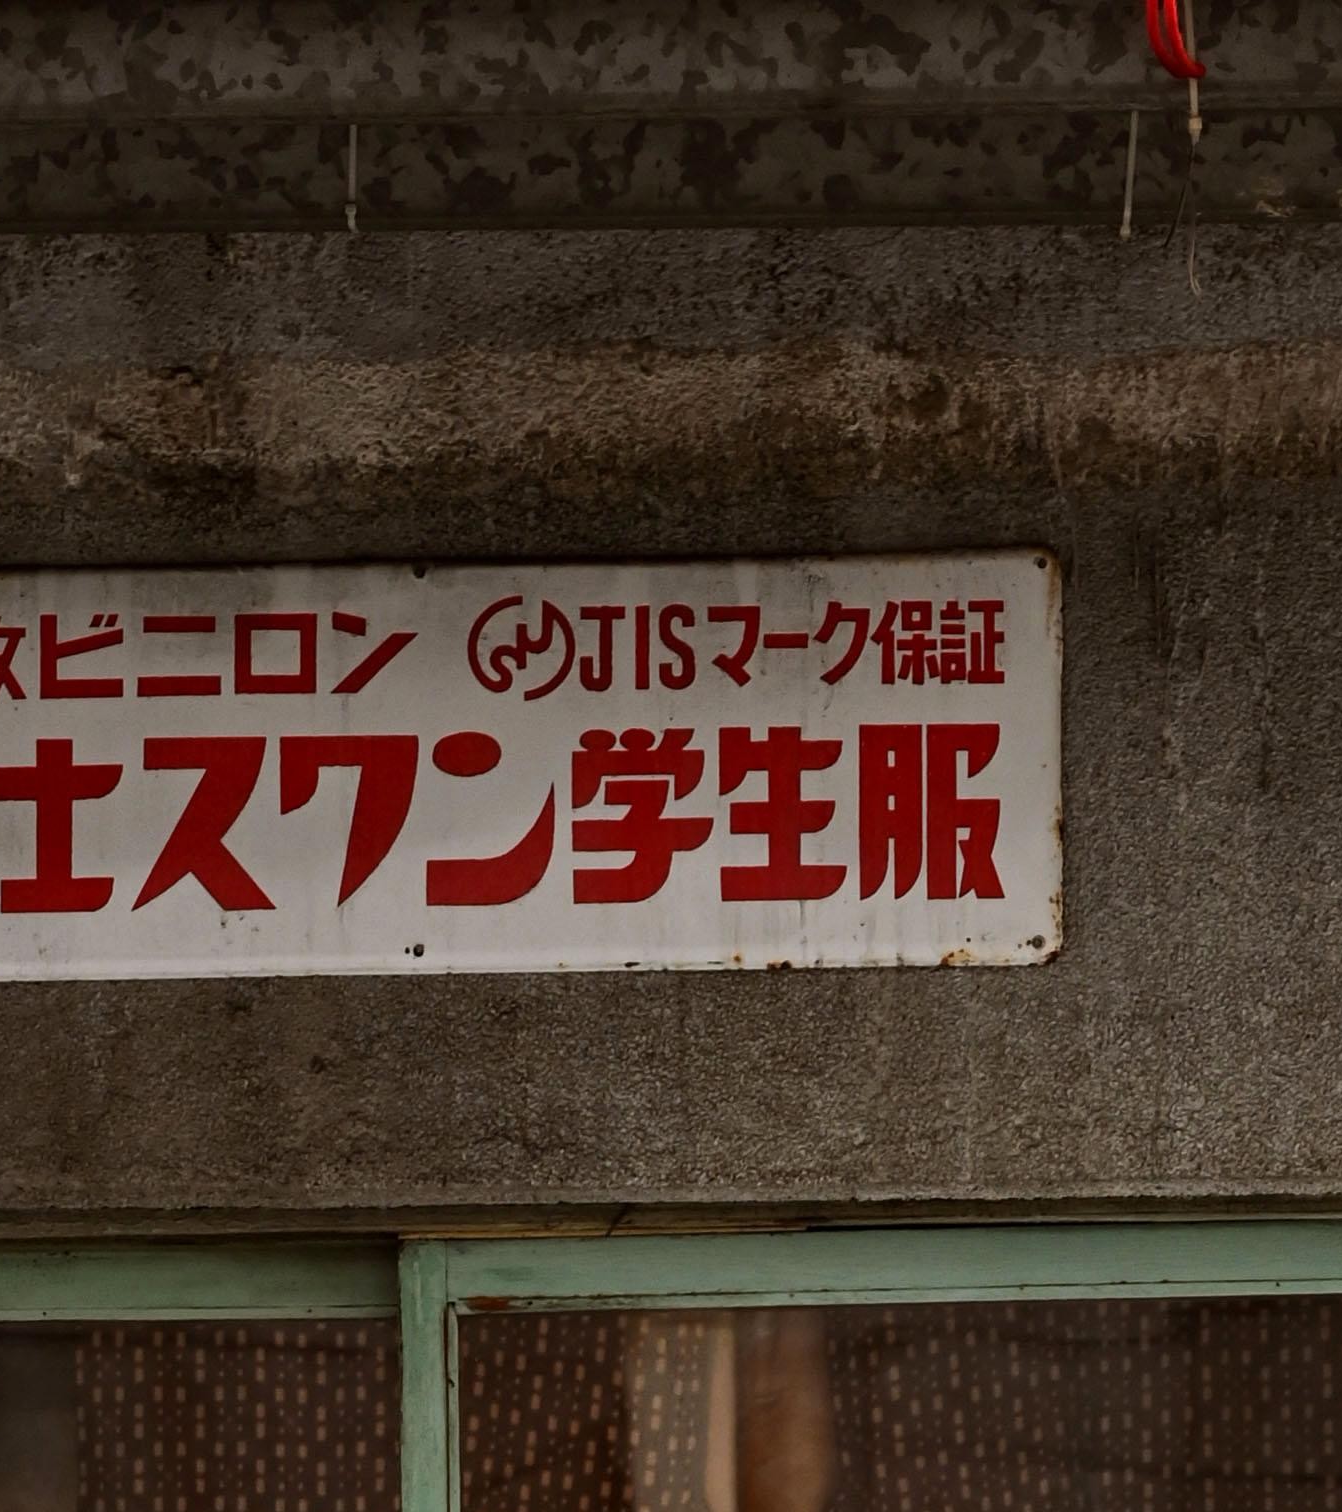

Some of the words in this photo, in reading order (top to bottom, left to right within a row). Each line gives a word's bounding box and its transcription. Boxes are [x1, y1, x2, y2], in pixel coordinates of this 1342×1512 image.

[580, 602, 1007, 694] JISマーク保証
